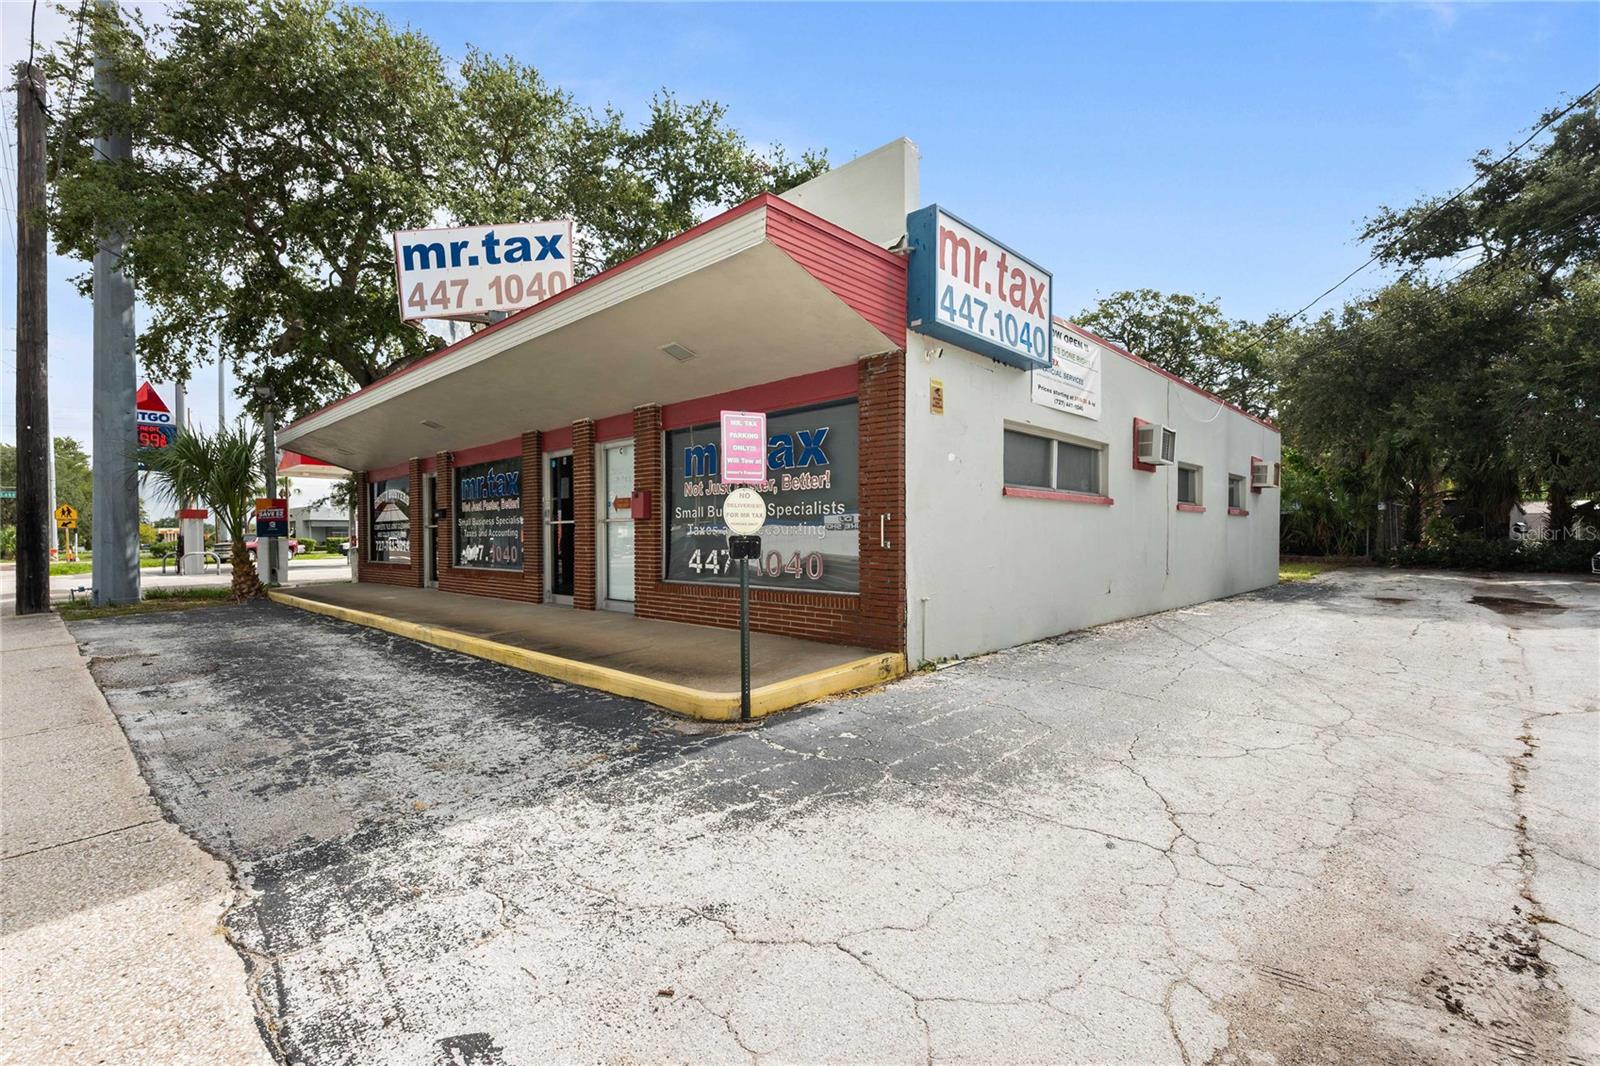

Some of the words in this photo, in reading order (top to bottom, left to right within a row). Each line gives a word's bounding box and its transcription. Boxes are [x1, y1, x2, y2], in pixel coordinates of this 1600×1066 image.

[402, 230, 565, 271] mr.tax
[939, 225, 1046, 320] mr.tax
[407, 271, 567, 312] 447.1040
[940, 284, 1046, 358] 447.1040
[1064, 335, 1083, 350] OPEN
[1038, 384, 1053, 394] Prices
[1053, 390, 1069, 400] starting
[136, 412, 170, 423] ITGO
[684, 426, 830, 479] max
[461, 467, 519, 500] mr.tax
[683, 482, 704, 497] Not
[705, 480, 732, 496] Just
[782, 470, 831, 491] Better!
[675, 506, 704, 519] Small
[767, 501, 846, 519] Specialists
[458, 518, 471, 527] Small
[471, 517, 495, 526] Business
[686, 523, 718, 536] Taxes
[464, 529, 477, 537] Taxes
[478, 529, 487, 537] and
[488, 529, 519, 540] Accounting
